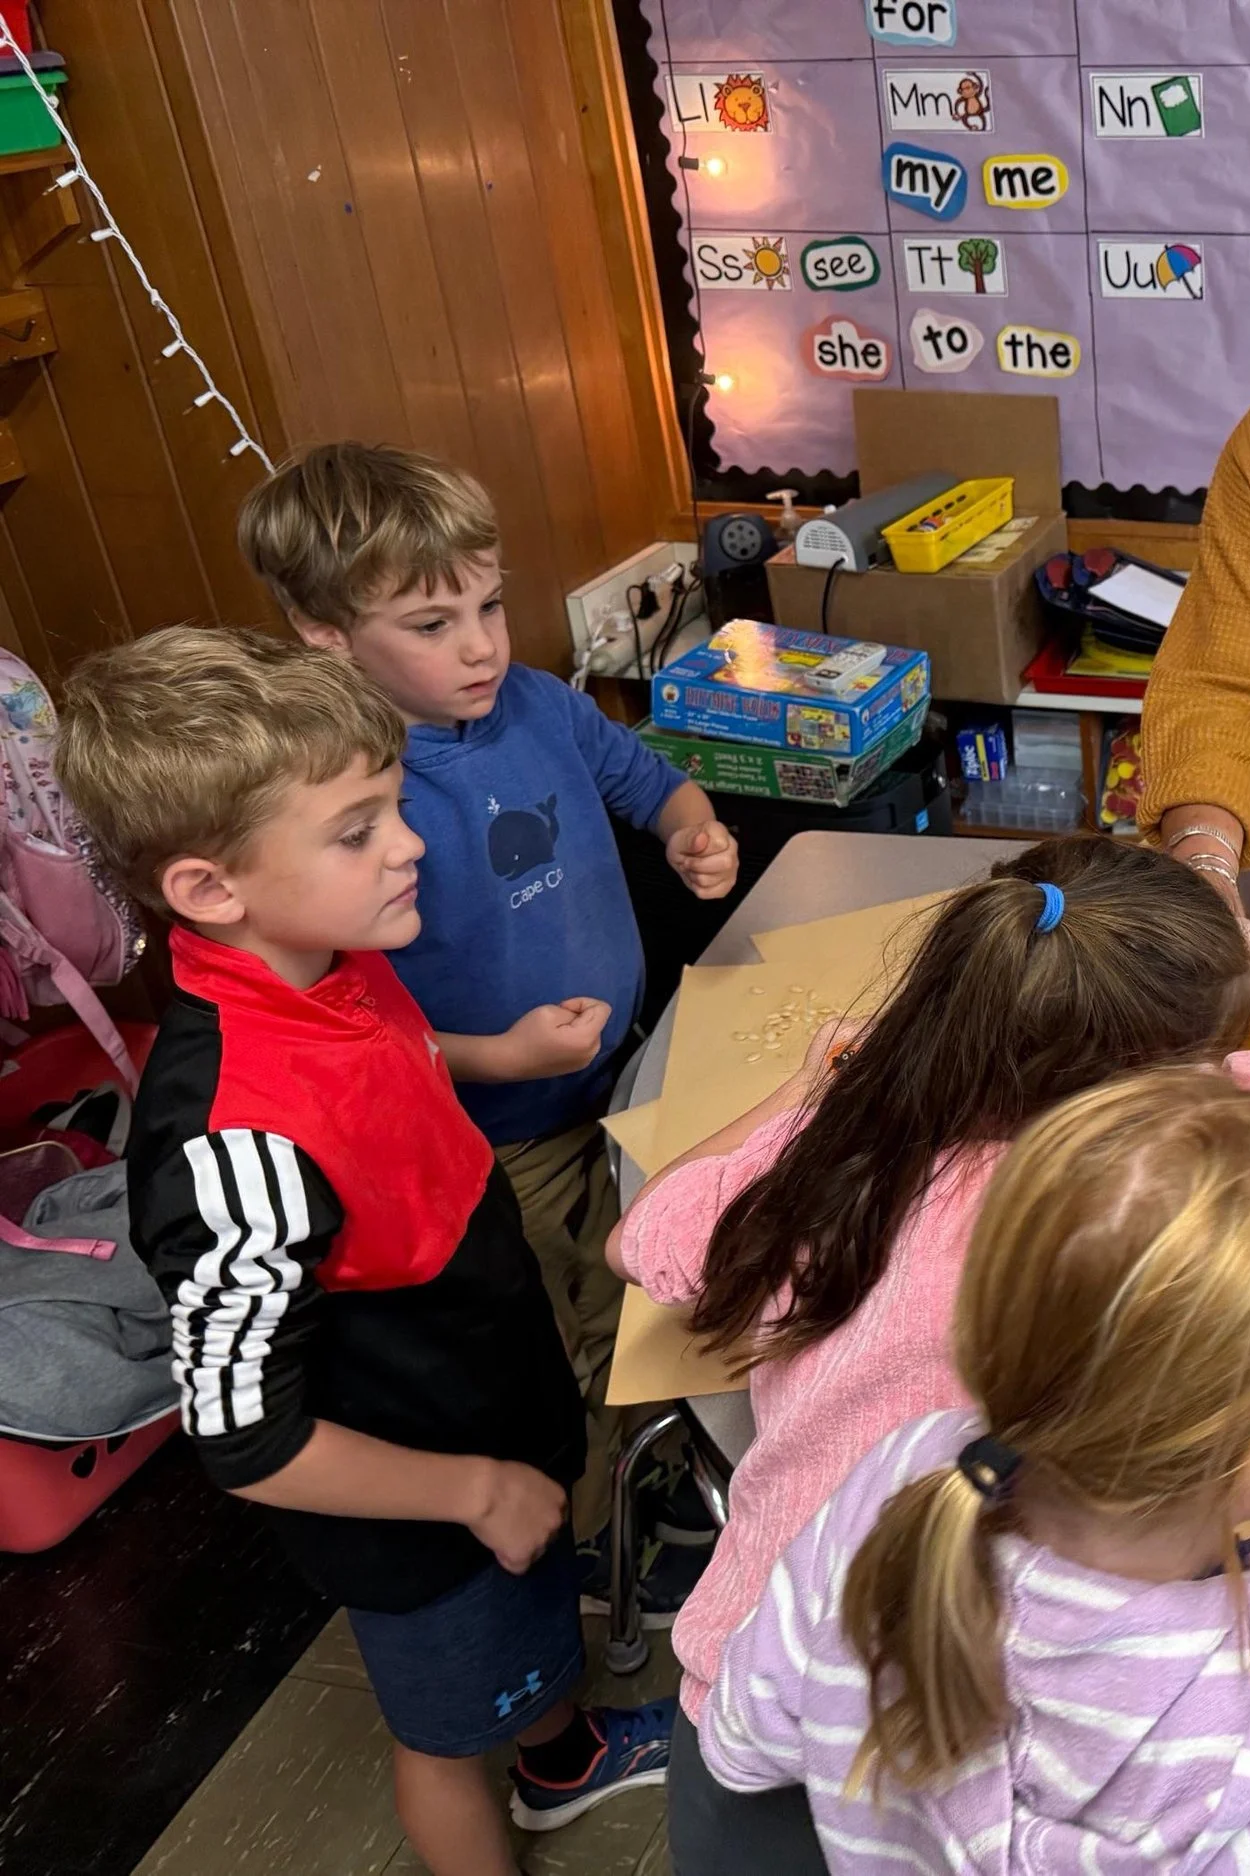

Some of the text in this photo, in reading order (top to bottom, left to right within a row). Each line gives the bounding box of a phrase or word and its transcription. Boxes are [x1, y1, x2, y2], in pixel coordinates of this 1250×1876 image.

[873, 0, 947, 34] for
[676, 82, 709, 124] Ll
[889, 82, 952, 118] Mm
[1098, 86, 1150, 127] Nn
[896, 158, 959, 209] my
[993, 166, 1056, 198] me
[697, 245, 743, 281] Ss
[813, 254, 867, 281] see
[907, 246, 953, 286] Tt
[1104, 250, 1156, 289] Uu
[817, 334, 882, 369] she
[923, 324, 968, 356] to
[1004, 333, 1071, 369] the
[510, 880, 544, 910] Cape
